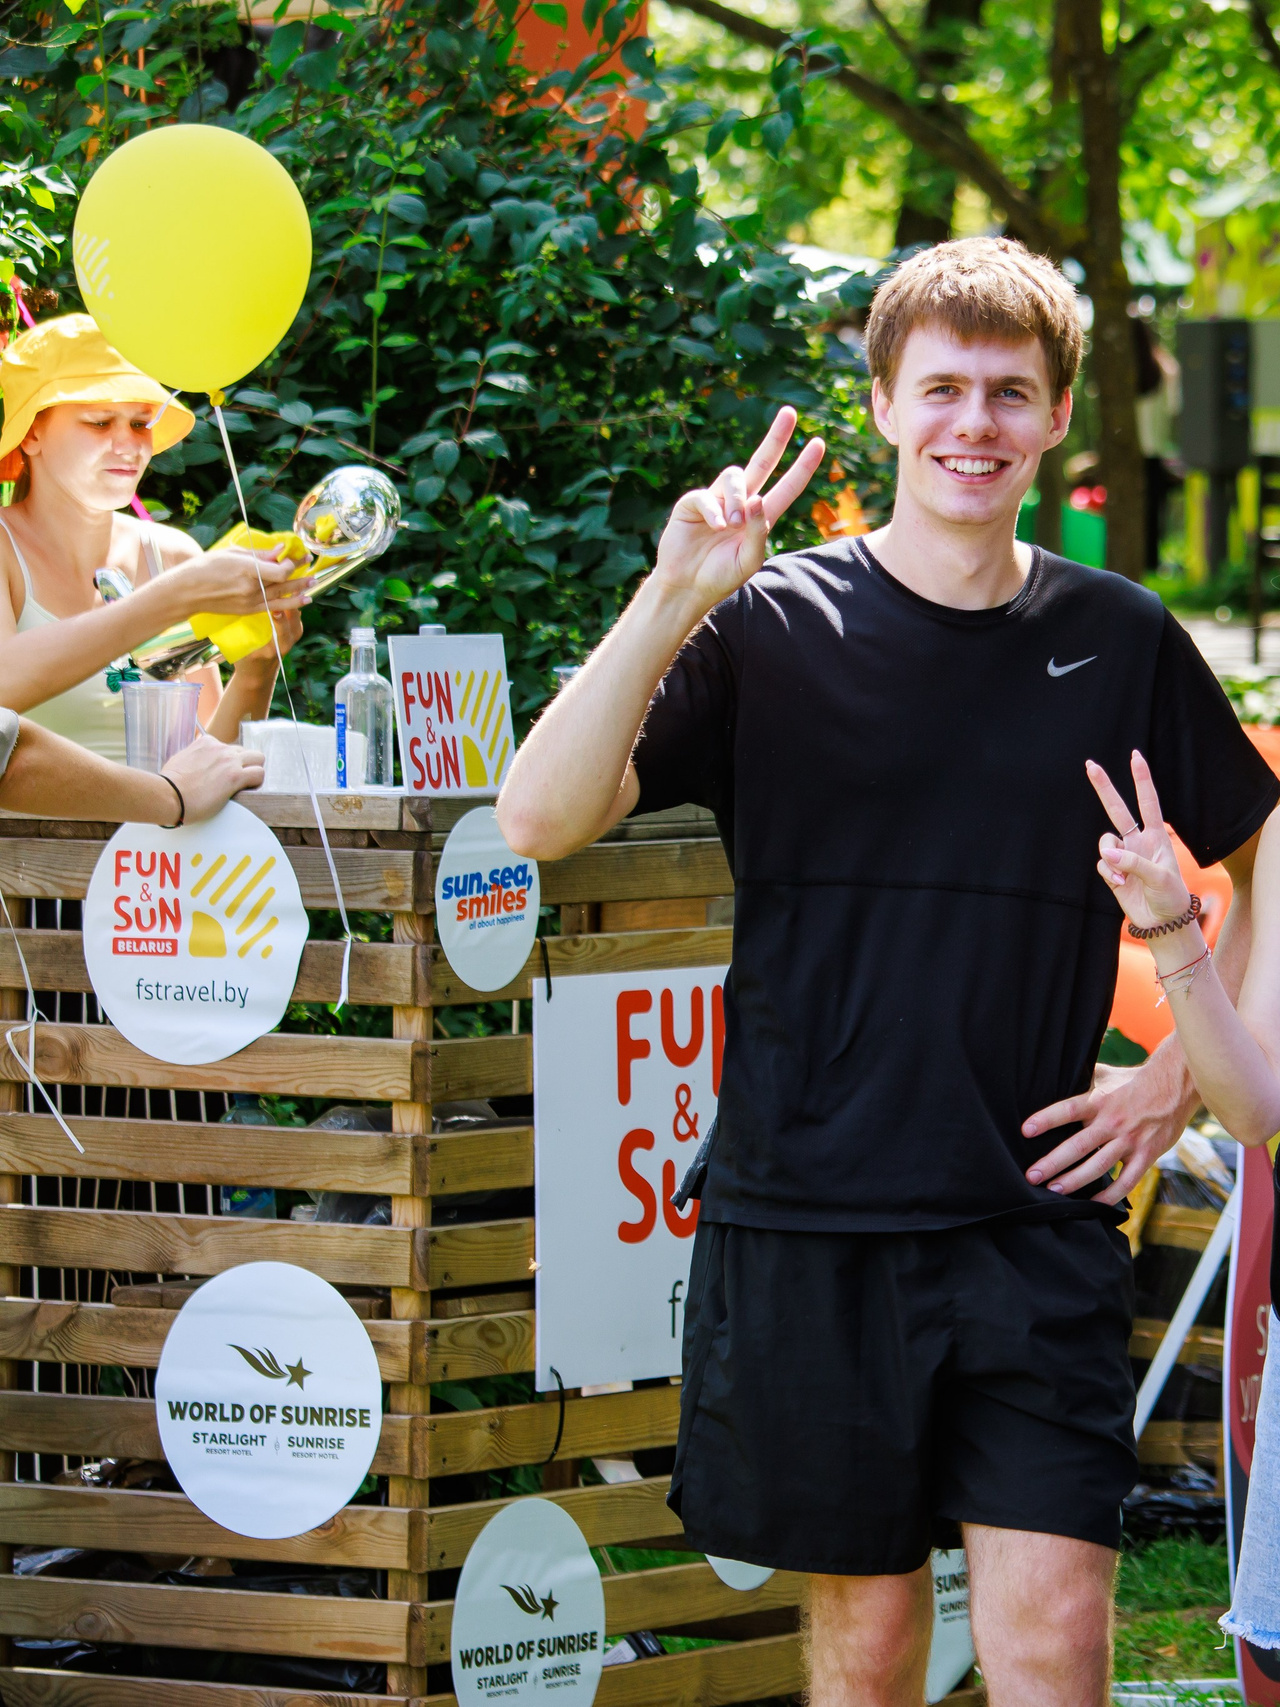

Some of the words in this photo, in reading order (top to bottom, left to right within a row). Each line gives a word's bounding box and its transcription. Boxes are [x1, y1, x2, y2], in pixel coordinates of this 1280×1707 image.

[402, 671, 454, 726] FUN
[426, 717, 437, 744] &
[409, 735, 461, 790] SUN
[114, 850, 181, 890] FUN
[140, 882, 152, 902] &
[456, 883, 527, 922] smiles
[113, 895, 182, 934] SUN
[478, 918, 495, 929] about
[117, 939, 173, 954] BELARUS
[136, 978, 249, 1009] fstravel.by
[673, 1083, 699, 1143] &
[617, 1128, 701, 1244] SU
[168, 1401, 245, 1423] WORLD
[250, 1404, 277, 1424] OF
[281, 1405, 371, 1428] SUNRISE
[192, 1432, 267, 1447] STARLIGHT
[206, 1448, 231, 1456] RESORT
[233, 1449, 253, 1457] HOTEL
[287, 1436, 345, 1450] SUNRISE
[292, 1452, 317, 1460] RESORT
[459, 1643, 513, 1669] WORLD
[516, 1640, 535, 1661] OF
[537, 1631, 598, 1658] SUNRISE
[477, 1671, 528, 1690] STARLIGHT
[542, 1663, 581, 1680] SUNRISE
